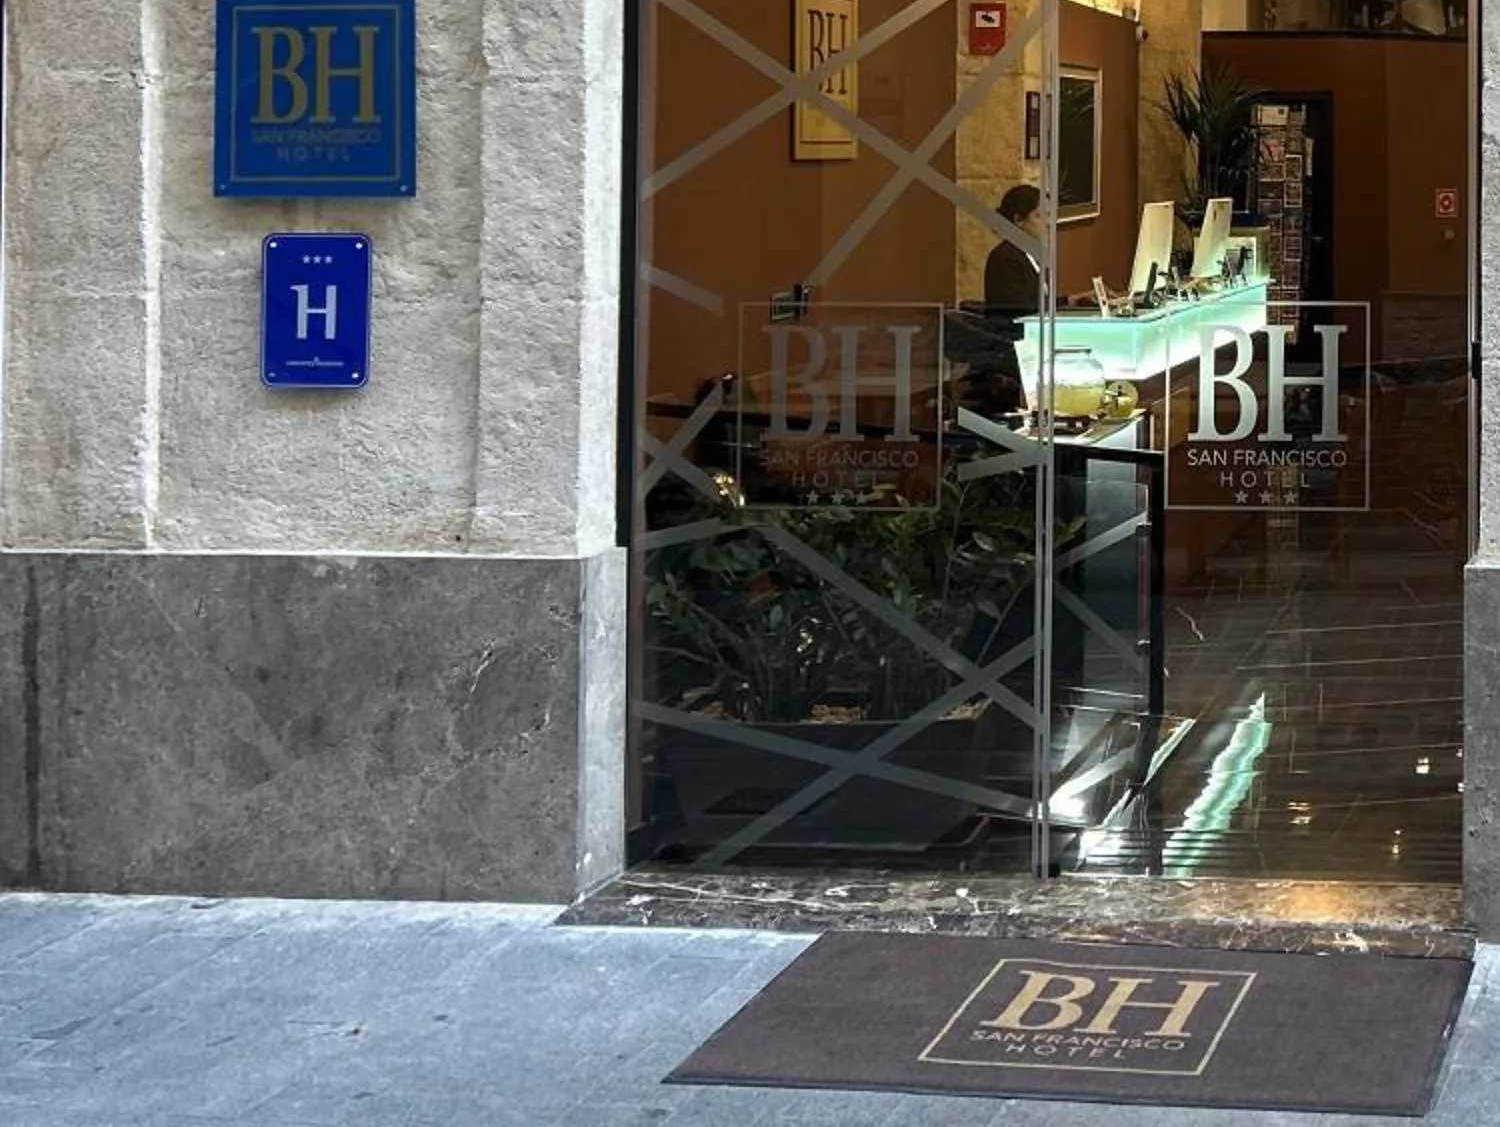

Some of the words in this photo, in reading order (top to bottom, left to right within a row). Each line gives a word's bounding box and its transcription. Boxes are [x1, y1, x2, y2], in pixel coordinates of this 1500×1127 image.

[250, 26, 381, 123] BH
[289, 284, 337, 340] H
[759, 325, 922, 442] BH
[1187, 324, 1348, 442] BH
[760, 450, 799, 466] SAN
[807, 450, 920, 468] FRANCISCO
[1187, 450, 1228, 466] SAN
[1233, 450, 1348, 467] FRANCISCO
[792, 471, 883, 488] HOTEL
[1220, 472, 1312, 488] HOTEL
[979, 970, 1220, 1037] BH
[969, 1030, 1026, 1042] SAN
[1032, 1033, 1185, 1051] FRANCISCO
[1005, 1044, 1127, 1060] HOTEL
